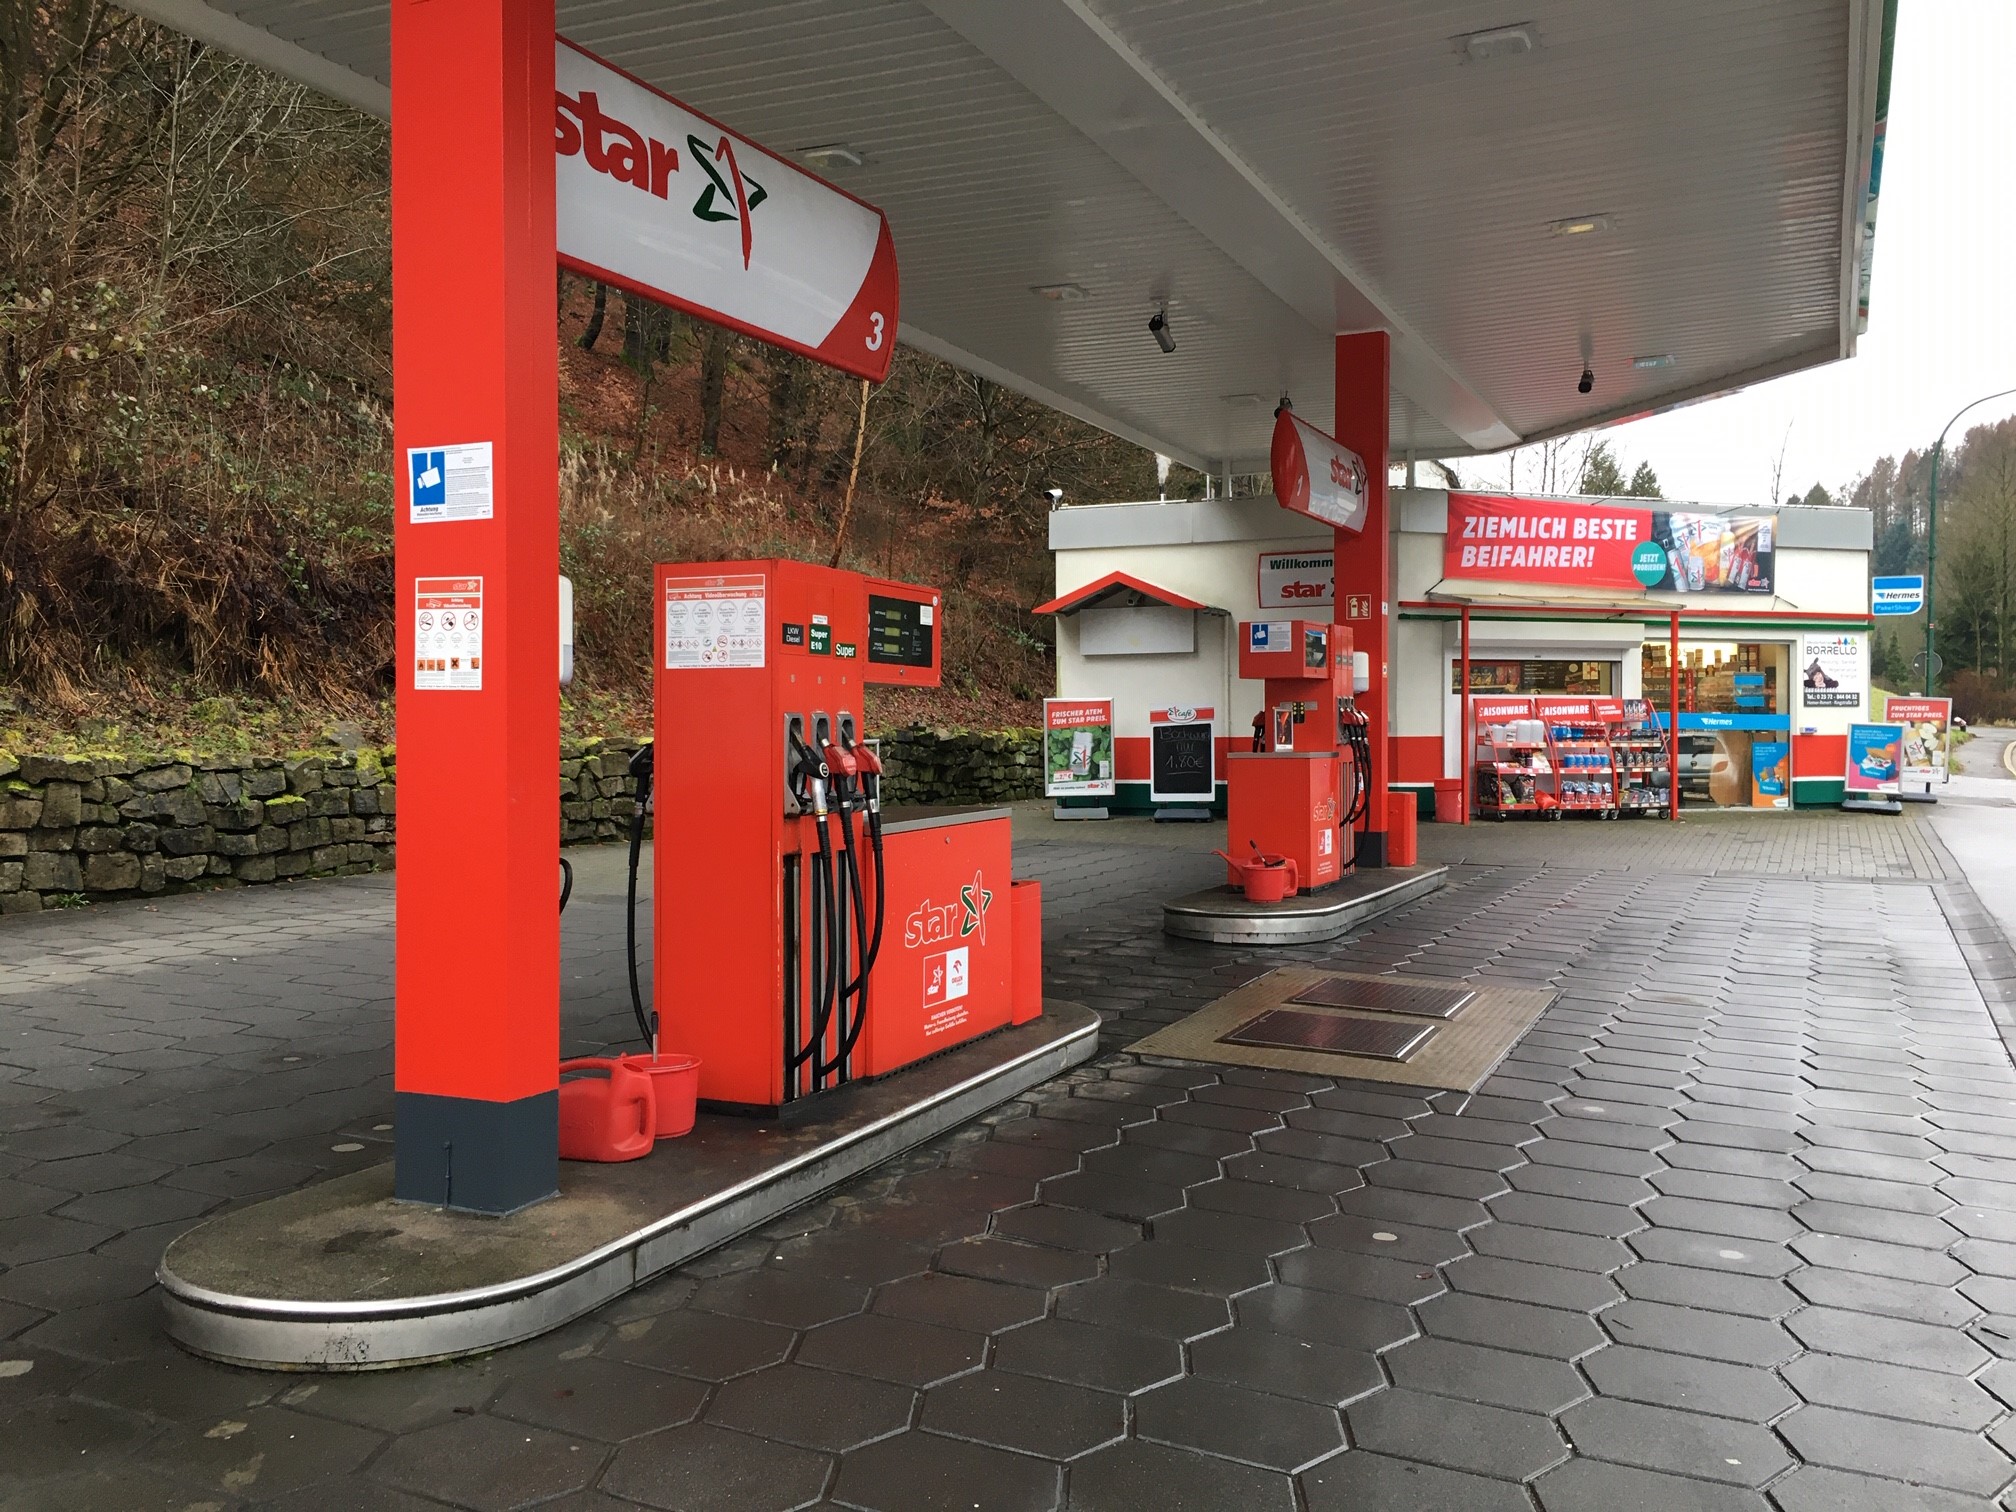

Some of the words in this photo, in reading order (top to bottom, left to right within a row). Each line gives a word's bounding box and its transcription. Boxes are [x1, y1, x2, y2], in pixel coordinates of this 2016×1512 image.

[555, 90, 679, 200] star
[865, 311, 885, 352] 3
[1330, 455, 1352, 491] star
[1462, 516, 1562, 540] ZIEMLICH
[1572, 517, 1638, 541] BESTE
[1460, 545, 1595, 568] BEIFAHRER!
[1639, 553, 1659, 563] JETZT
[1281, 581, 1326, 598] star
[1886, 592, 1920, 600] Hermes
[1875, 604, 1912, 612] PaketShop
[786, 635, 801, 643] Diesel
[811, 629, 828, 639] Super
[811, 641, 823, 650] E10
[835, 643, 855, 658] Super
[1806, 646, 1858, 655] BORRELLO
[1051, 709, 1084, 718] FRISCHER
[1085, 708, 1103, 716] ATEM
[1177, 709, 1192, 719] café
[1086, 715, 1108, 723] PREIS.
[1707, 717, 1733, 726] Hermes
[904, 898, 958, 948] star
